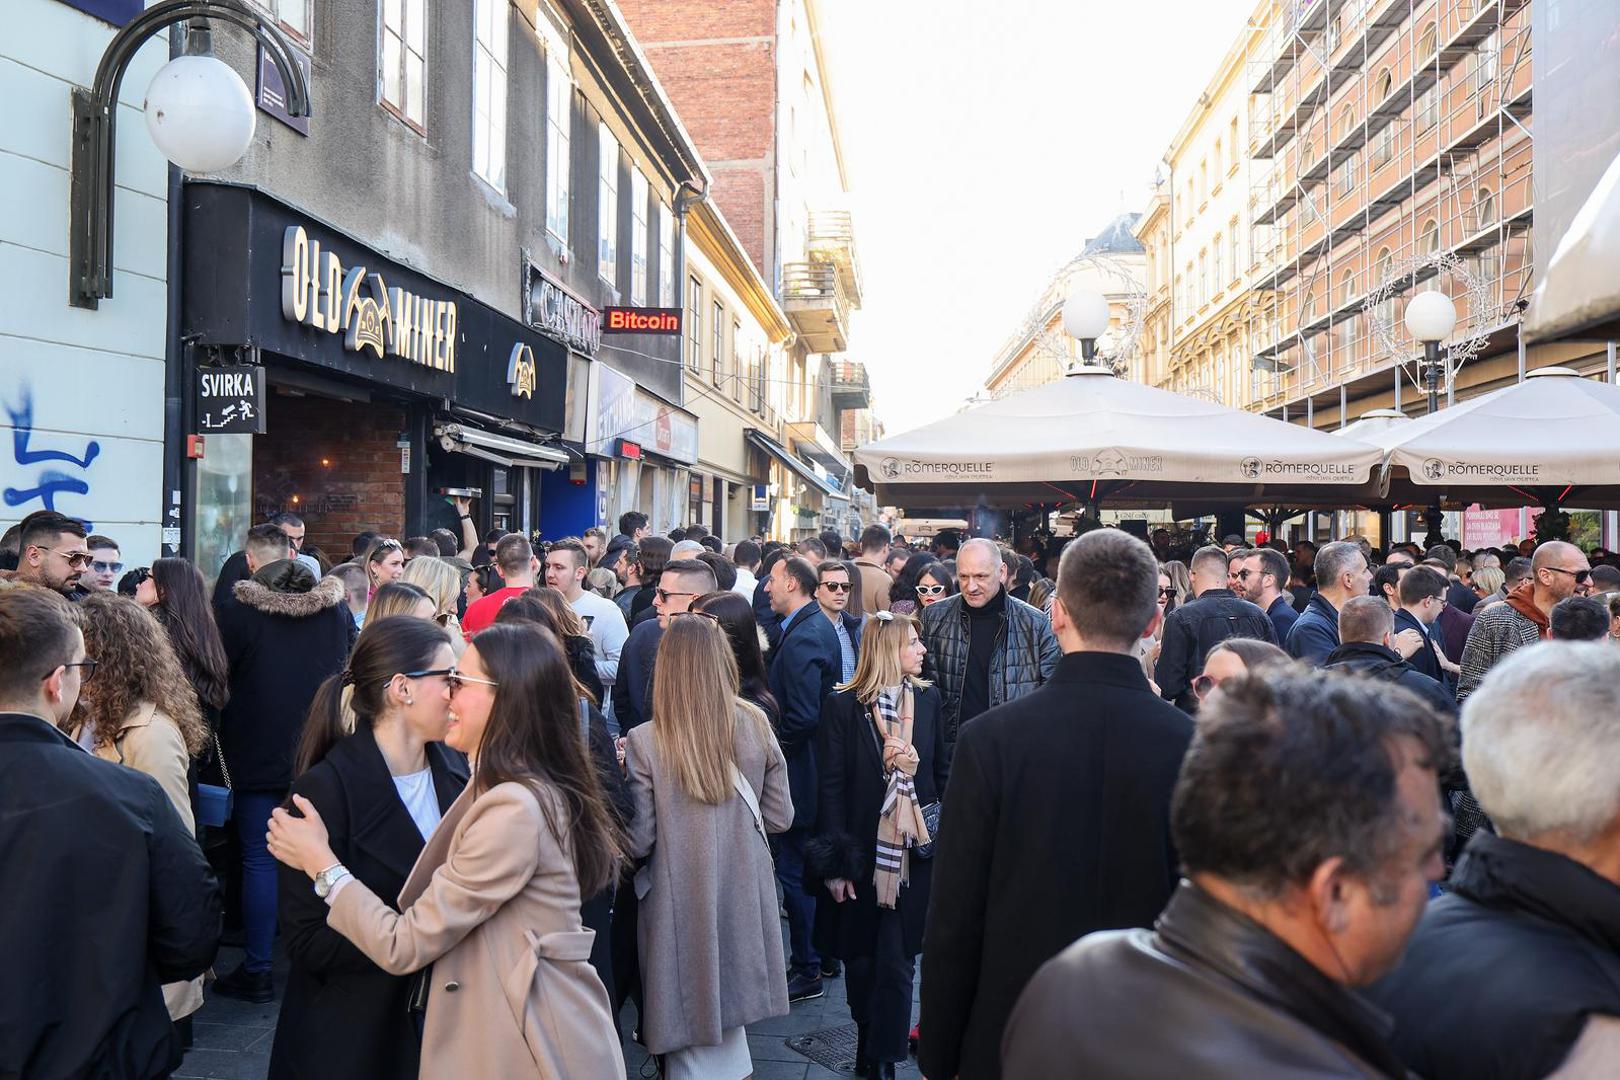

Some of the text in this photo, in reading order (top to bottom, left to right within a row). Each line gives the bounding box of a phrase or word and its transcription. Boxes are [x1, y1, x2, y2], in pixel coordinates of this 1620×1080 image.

[282, 225, 457, 374] OLD MINER
[609, 310, 679, 330] Bitcoin
[201, 373, 254, 397] SVIRKA
[1070, 455, 1163, 472] OLD MINER
